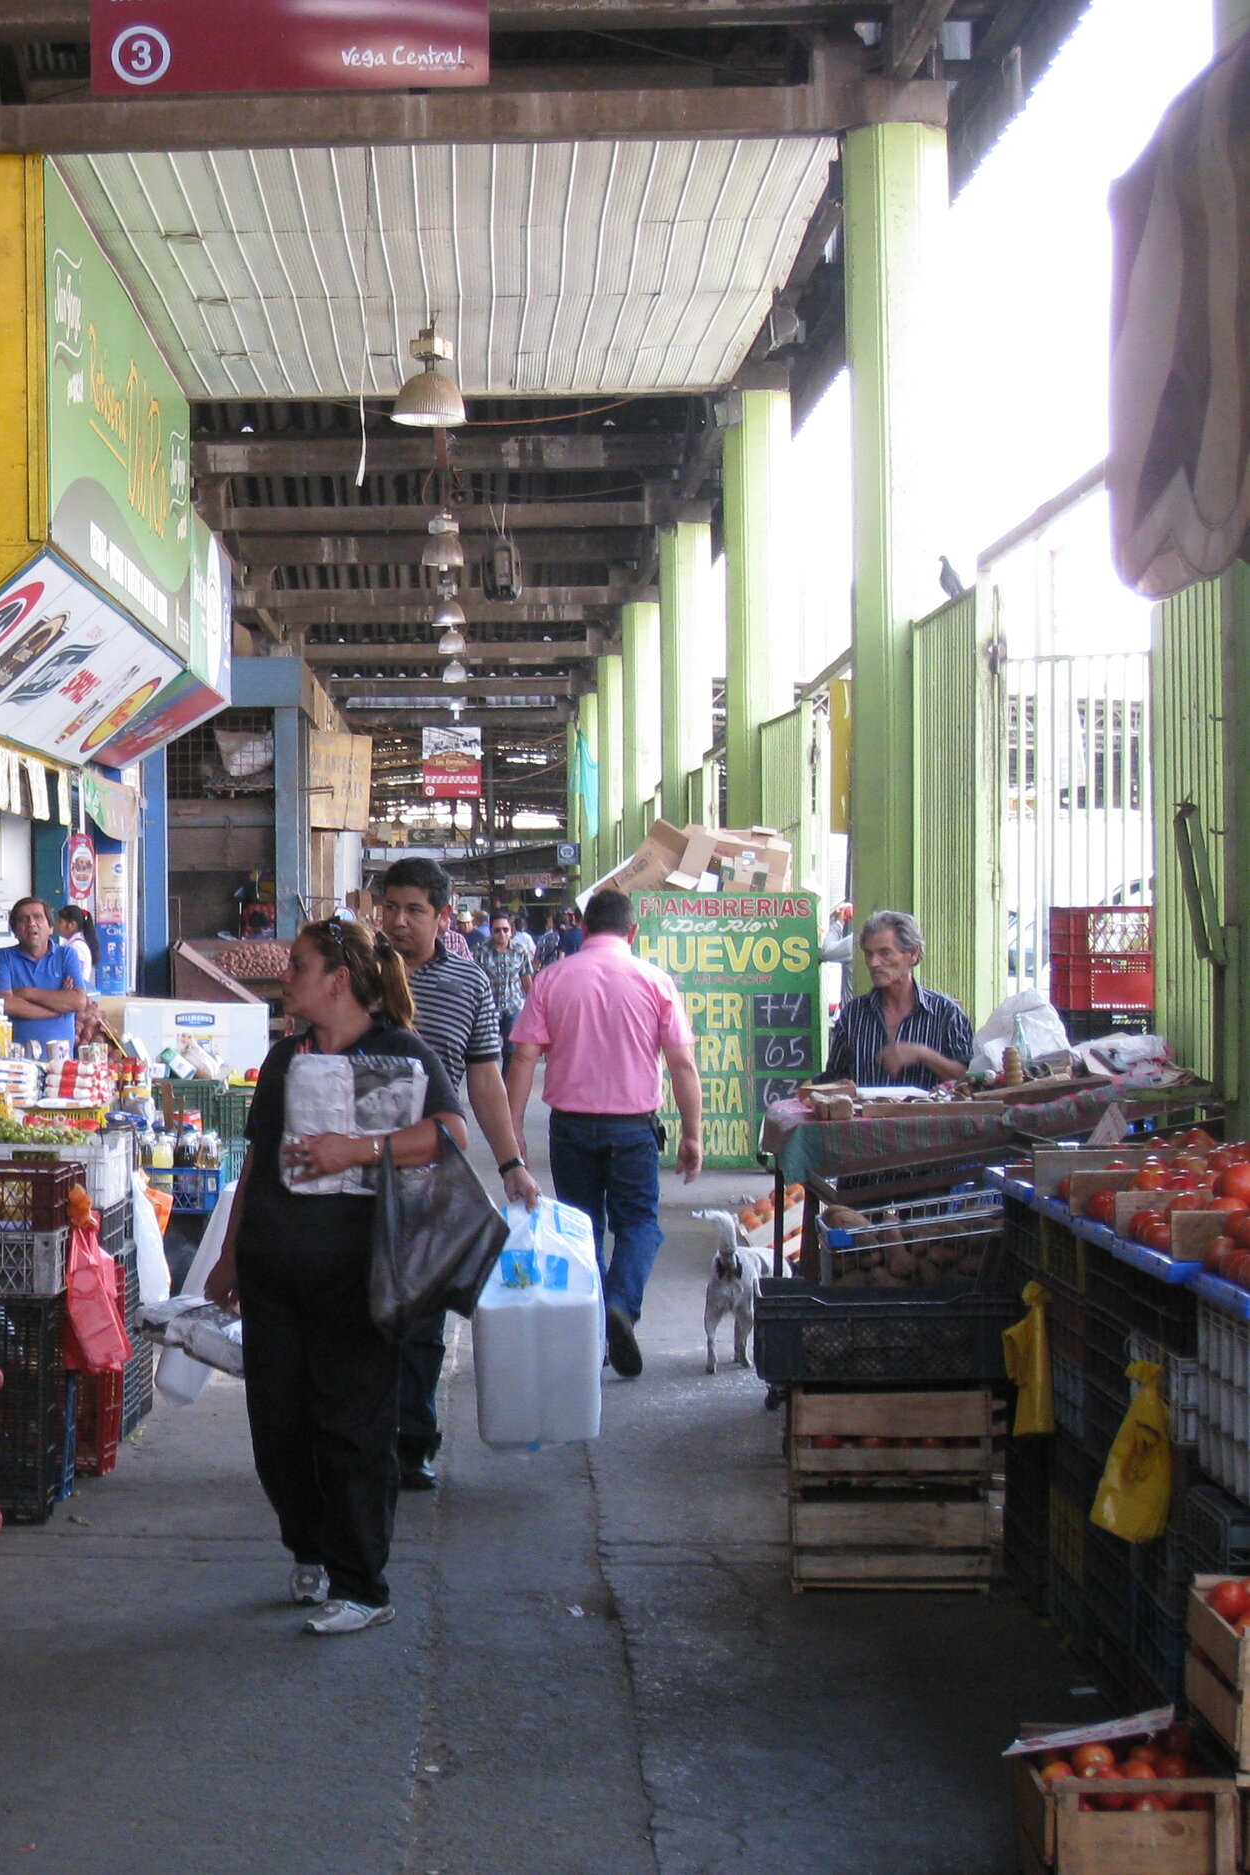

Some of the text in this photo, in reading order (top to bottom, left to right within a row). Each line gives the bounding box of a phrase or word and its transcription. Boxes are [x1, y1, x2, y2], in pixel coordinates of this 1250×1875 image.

[130, 40, 152, 71] 3
[341, 45, 466, 68] Vega Central
[639, 897, 812, 918] FIAMBRERIAS
[639, 936, 811, 973] HUEVOS
[693, 974, 772, 985] MAYOR
[682, 993, 743, 1029] PER
[764, 1034, 805, 1068] 65
